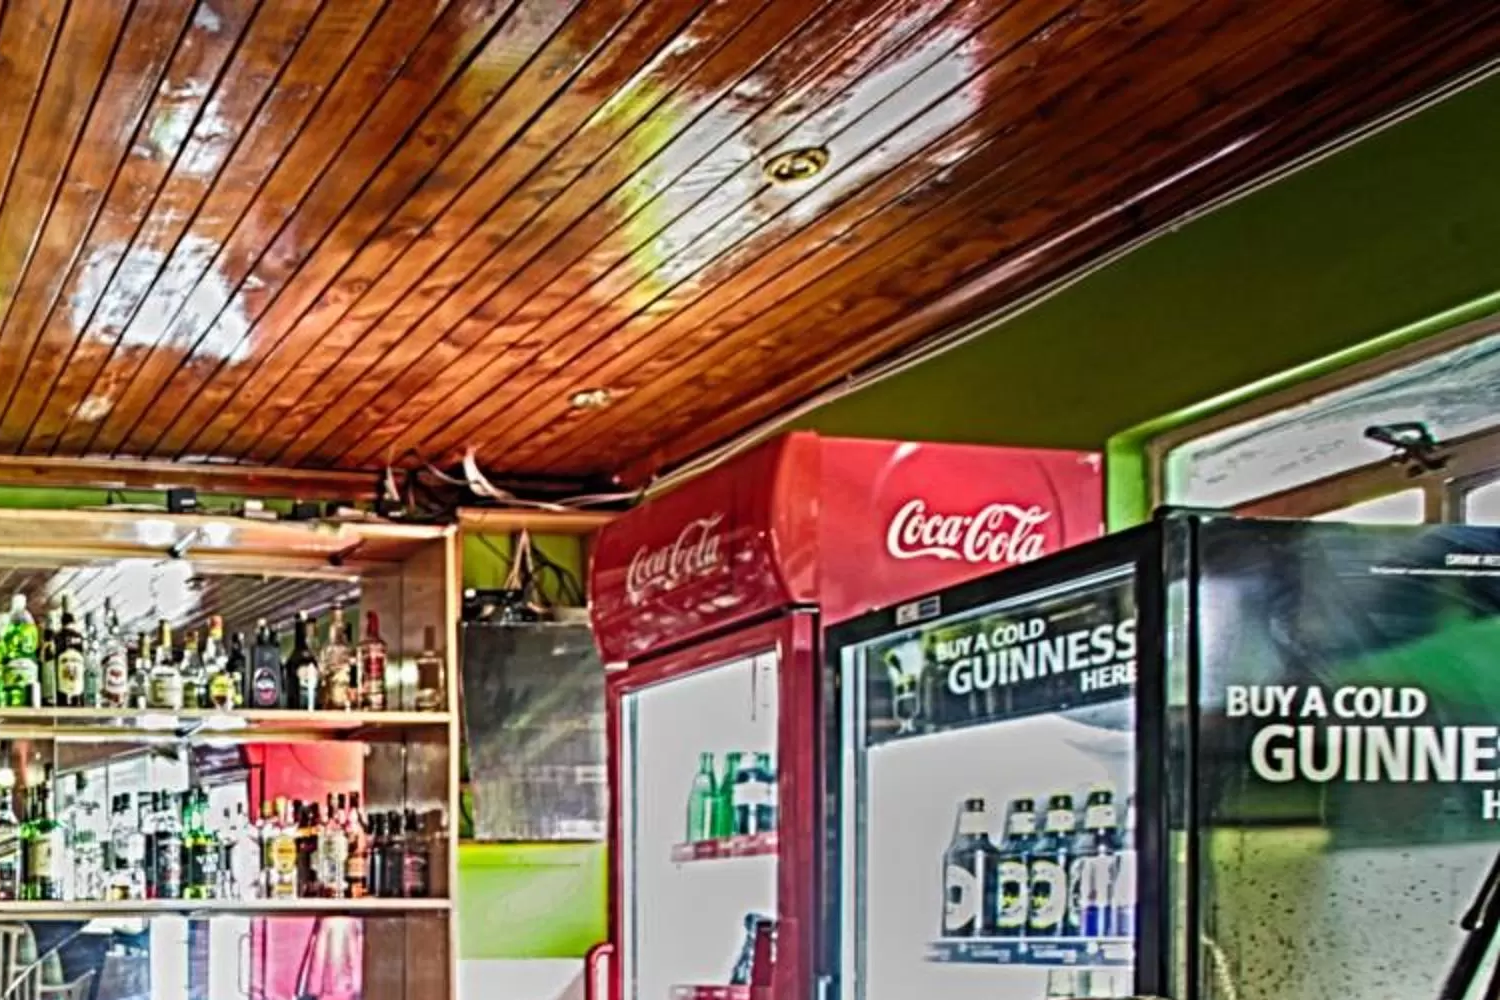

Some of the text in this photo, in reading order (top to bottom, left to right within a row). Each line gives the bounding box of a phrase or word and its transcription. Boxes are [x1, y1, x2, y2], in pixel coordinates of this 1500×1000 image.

[626, 511, 726, 606] Coca-Cola
[887, 499, 1051, 563] Coca-Cola
[935, 618, 1046, 662] BUY A COLD
[948, 618, 1137, 695] GUINNESS
[1079, 660, 1137, 692] HERE
[1226, 686, 1428, 718] BUY A COLD
[1251, 723, 1500, 782] GUINNE
